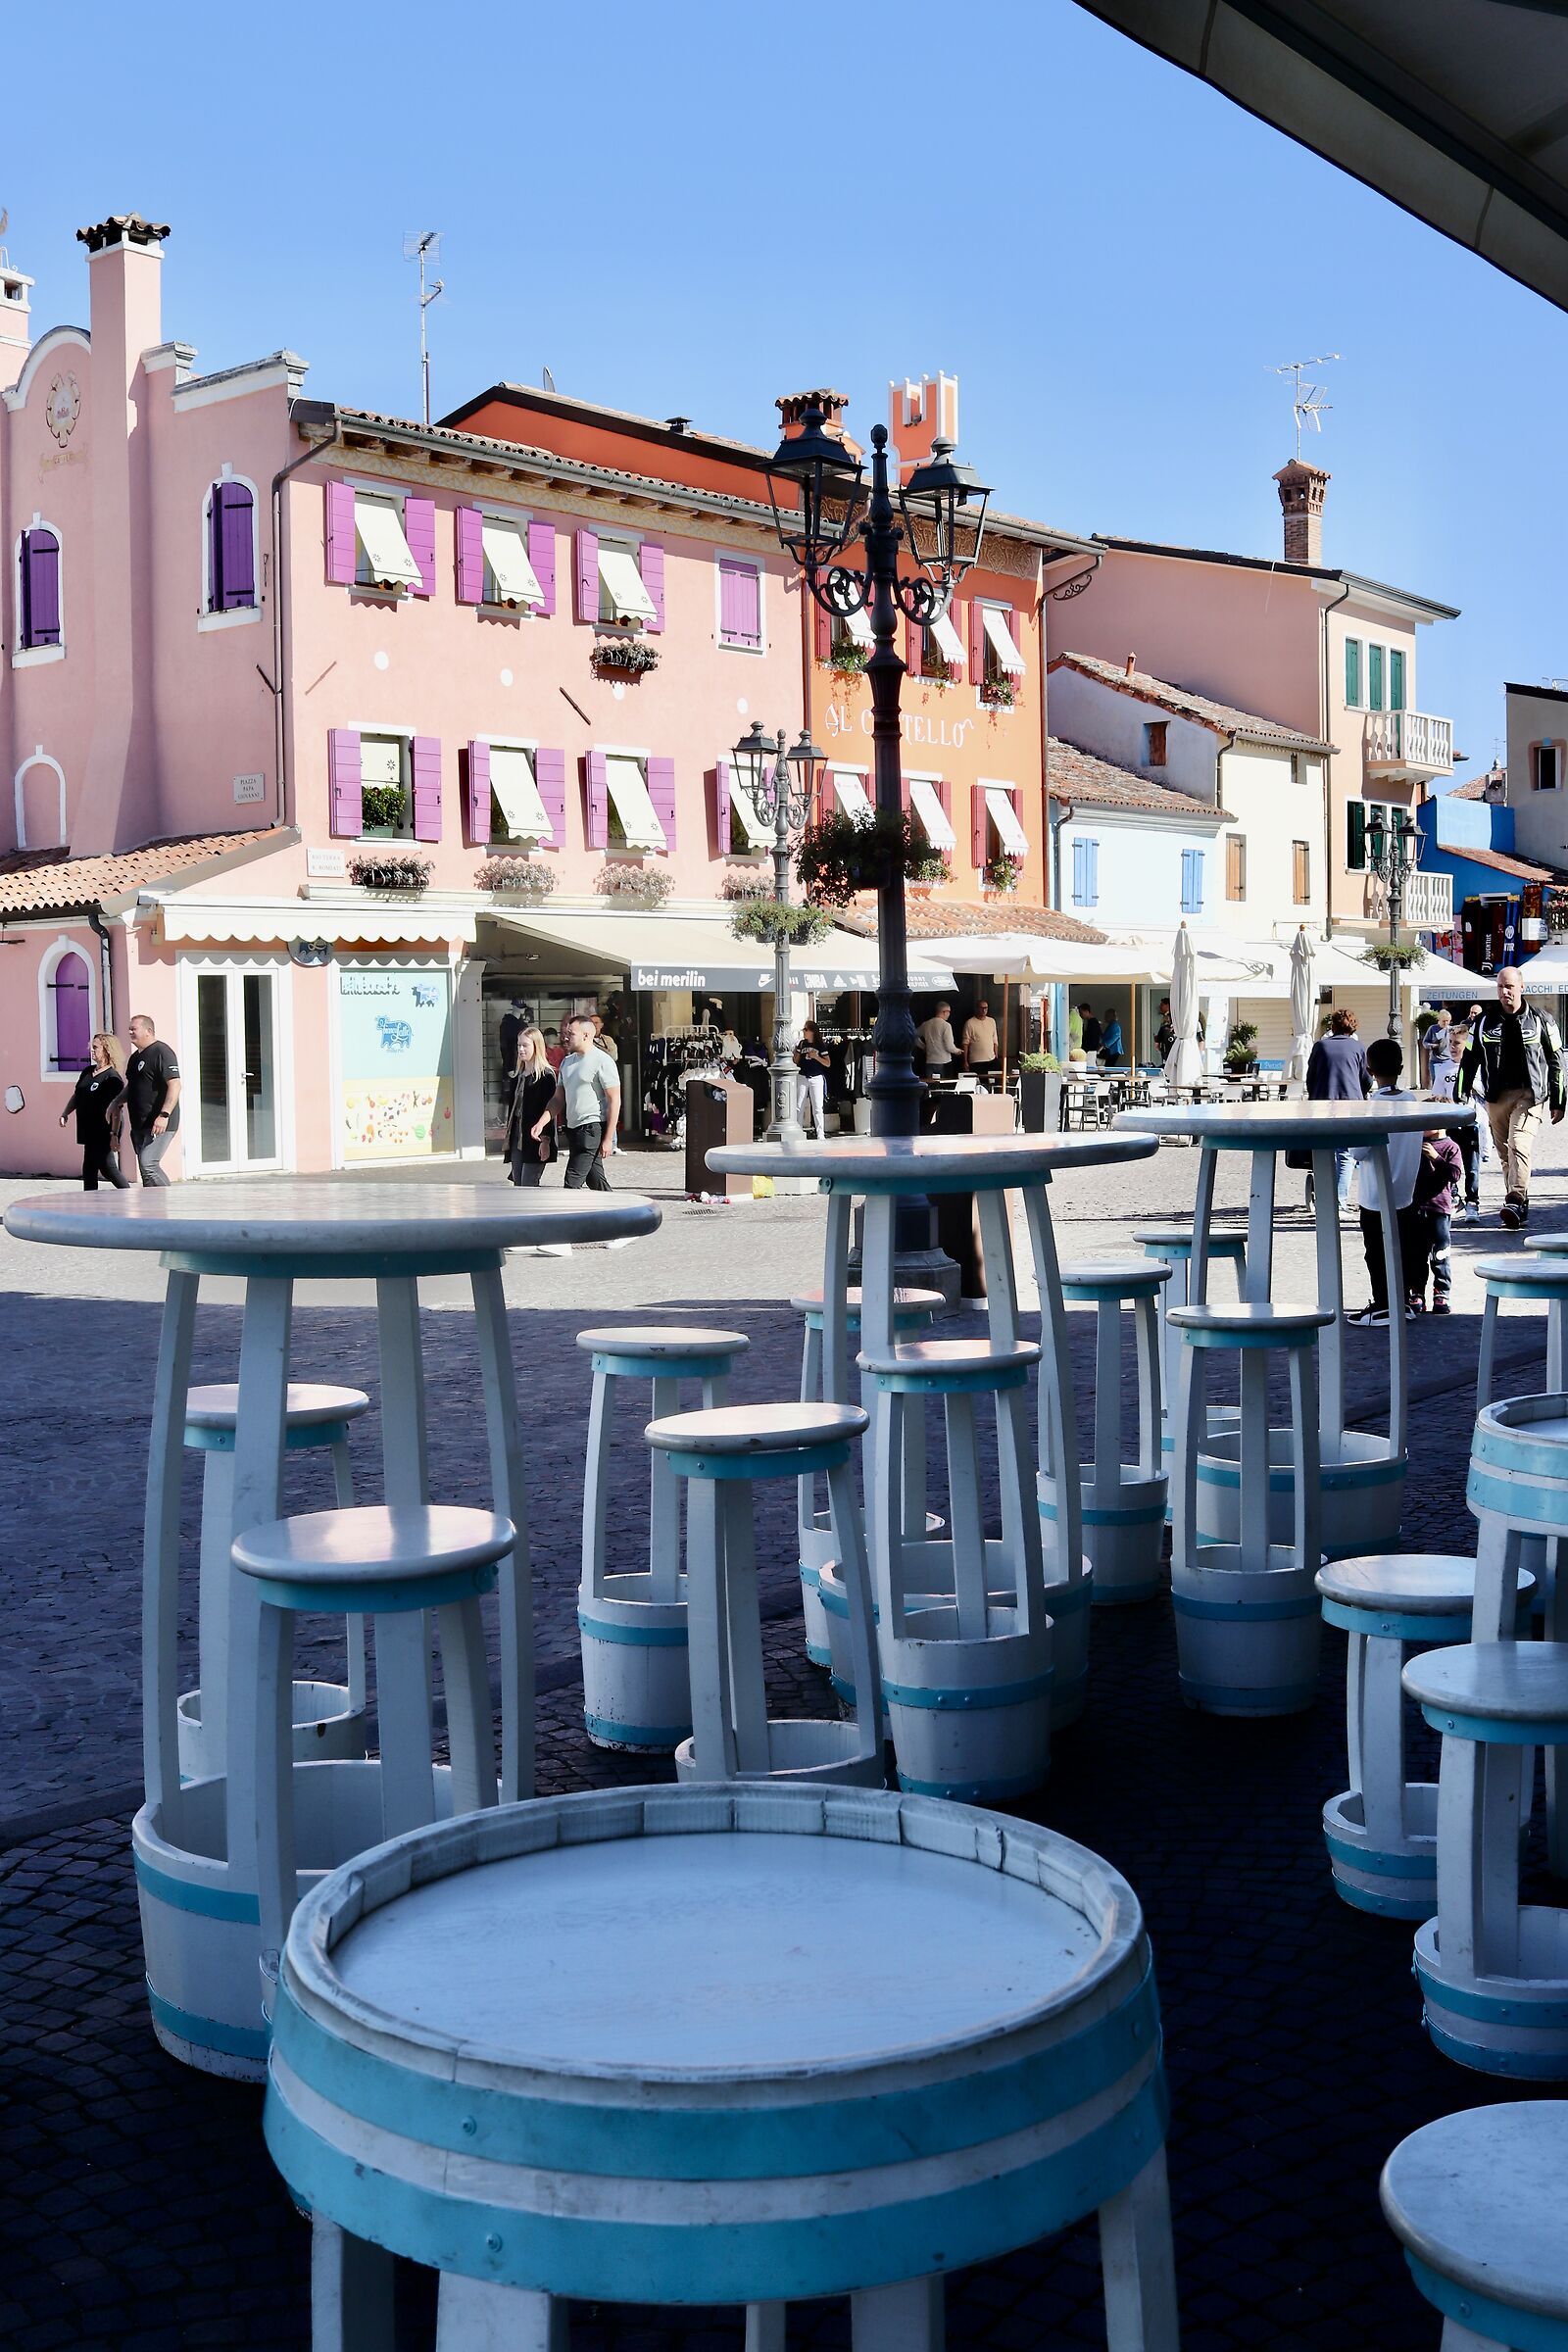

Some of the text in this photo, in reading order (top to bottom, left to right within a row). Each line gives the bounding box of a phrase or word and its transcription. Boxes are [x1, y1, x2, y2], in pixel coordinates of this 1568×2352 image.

[824, 704, 974, 748] AL CTELLO
[638, 968, 706, 987] bei merilin
[1426, 991, 1478, 1000] ZEITUNGEN
